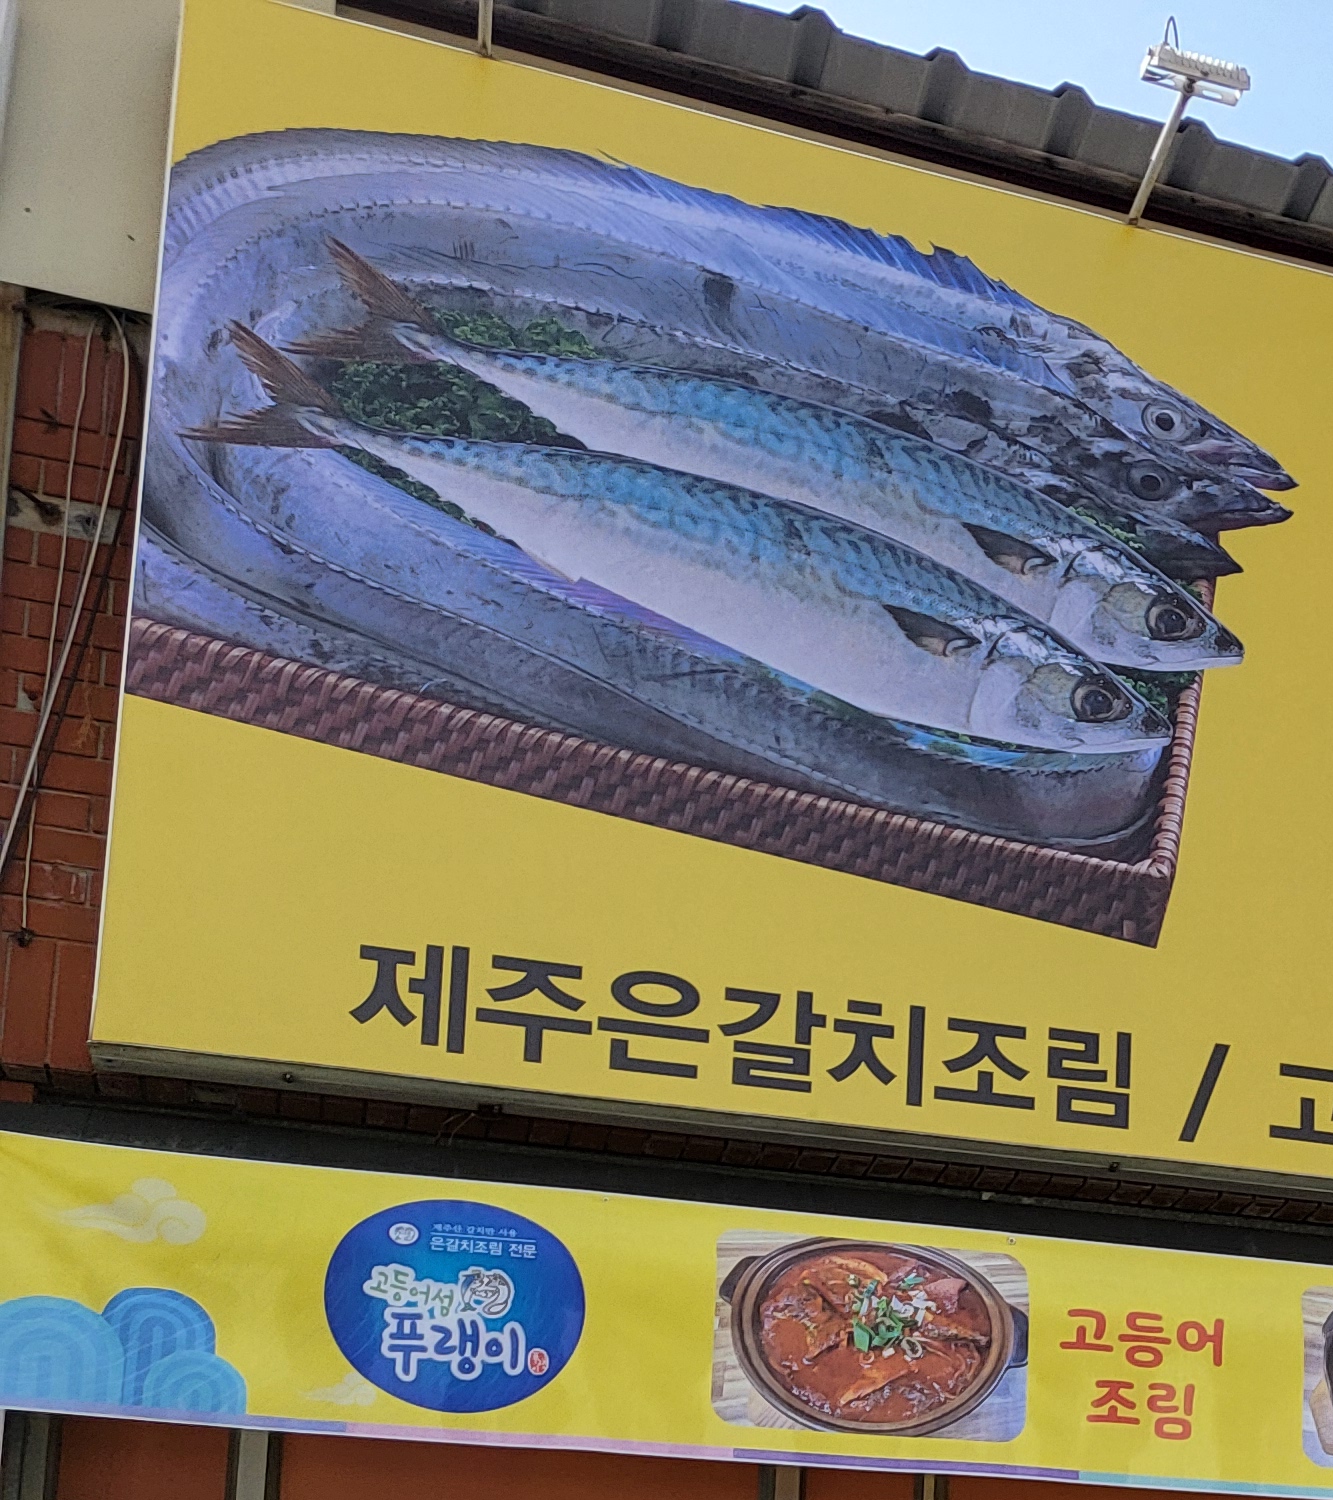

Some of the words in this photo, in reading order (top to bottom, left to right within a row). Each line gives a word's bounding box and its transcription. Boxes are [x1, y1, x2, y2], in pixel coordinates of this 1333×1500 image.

[350, 942, 1133, 1131] 제주은갈치조림
[1179, 1043, 1230, 1142] /
[430, 1237, 503, 1256] 은갈치조림
[508, 1242, 538, 1259] 전문
[386, 1311, 520, 1378] 푸랭이
[1060, 1308, 1225, 1368] 고등어
[1086, 1379, 1195, 1441] 조림
